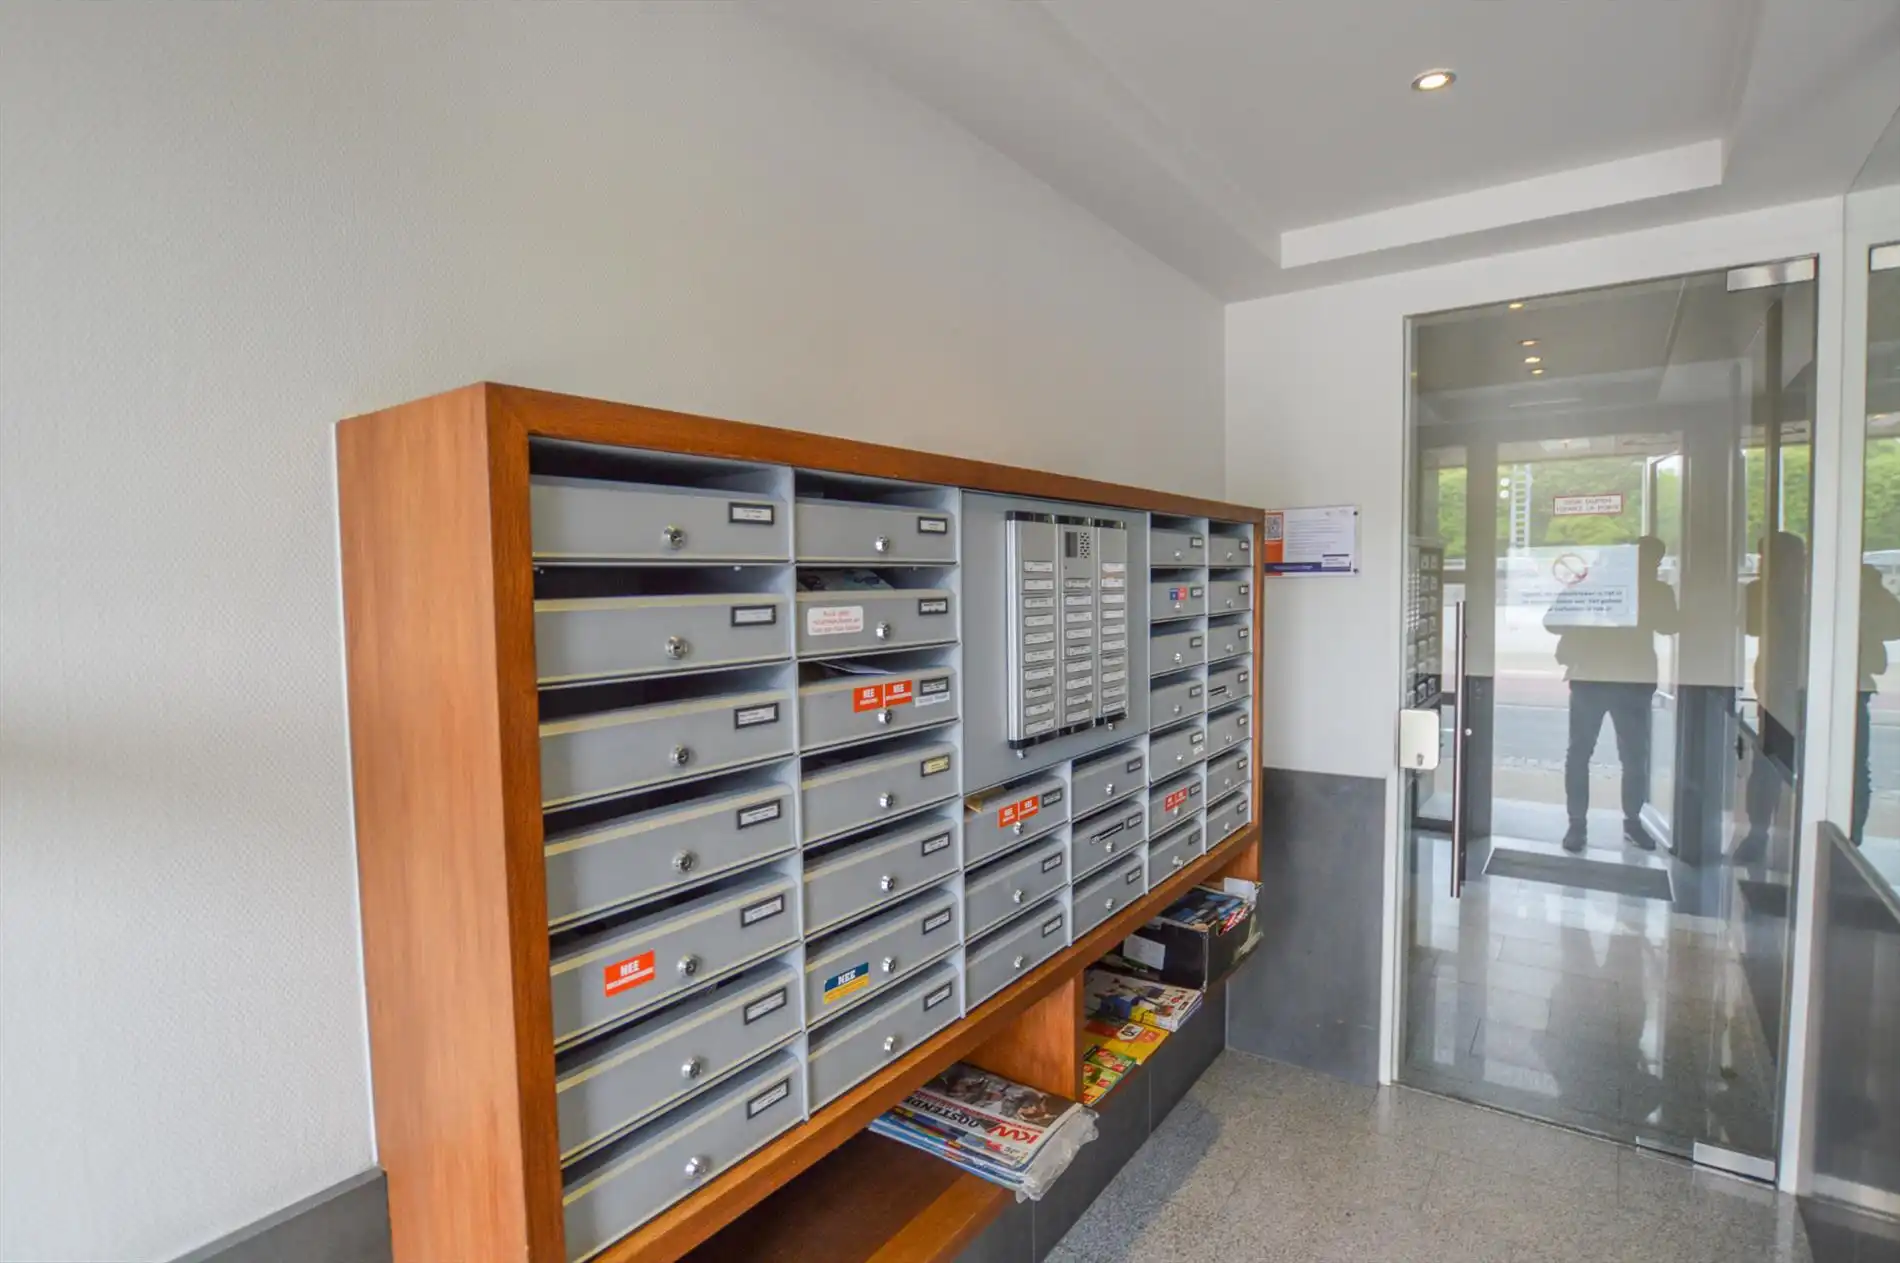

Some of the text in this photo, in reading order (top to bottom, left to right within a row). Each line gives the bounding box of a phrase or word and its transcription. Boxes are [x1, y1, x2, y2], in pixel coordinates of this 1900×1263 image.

[620, 960, 640, 976] NEE
[837, 969, 856, 985] NEE
[987, 1125, 1039, 1144] KW
